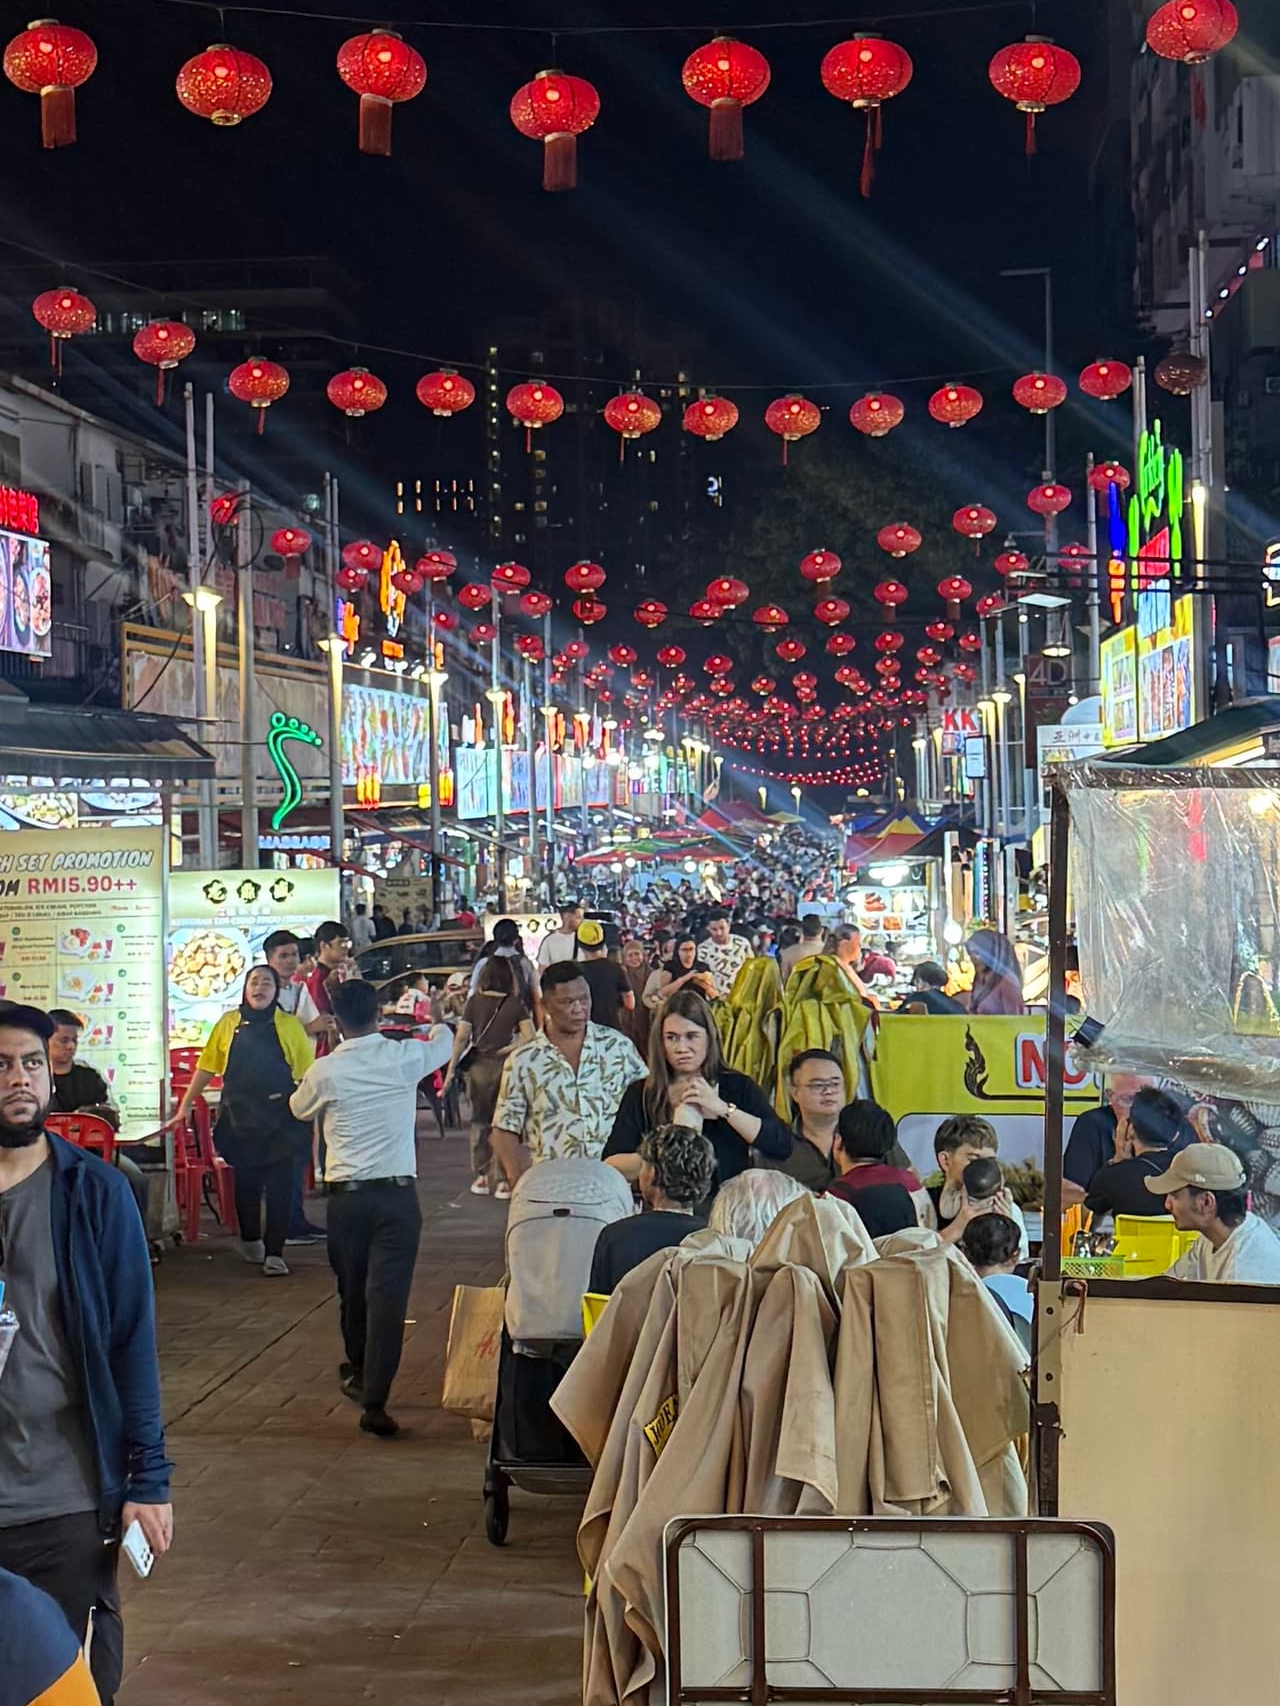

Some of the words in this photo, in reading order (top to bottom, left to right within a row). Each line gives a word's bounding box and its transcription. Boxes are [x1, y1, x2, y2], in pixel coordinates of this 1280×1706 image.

[1029, 658, 1067, 686] 4D
[943, 709, 979, 731] KK
[17, 853, 50, 872] SET
[51, 850, 154, 871] PROMOTION
[27, 875, 137, 895] RM15.90++
